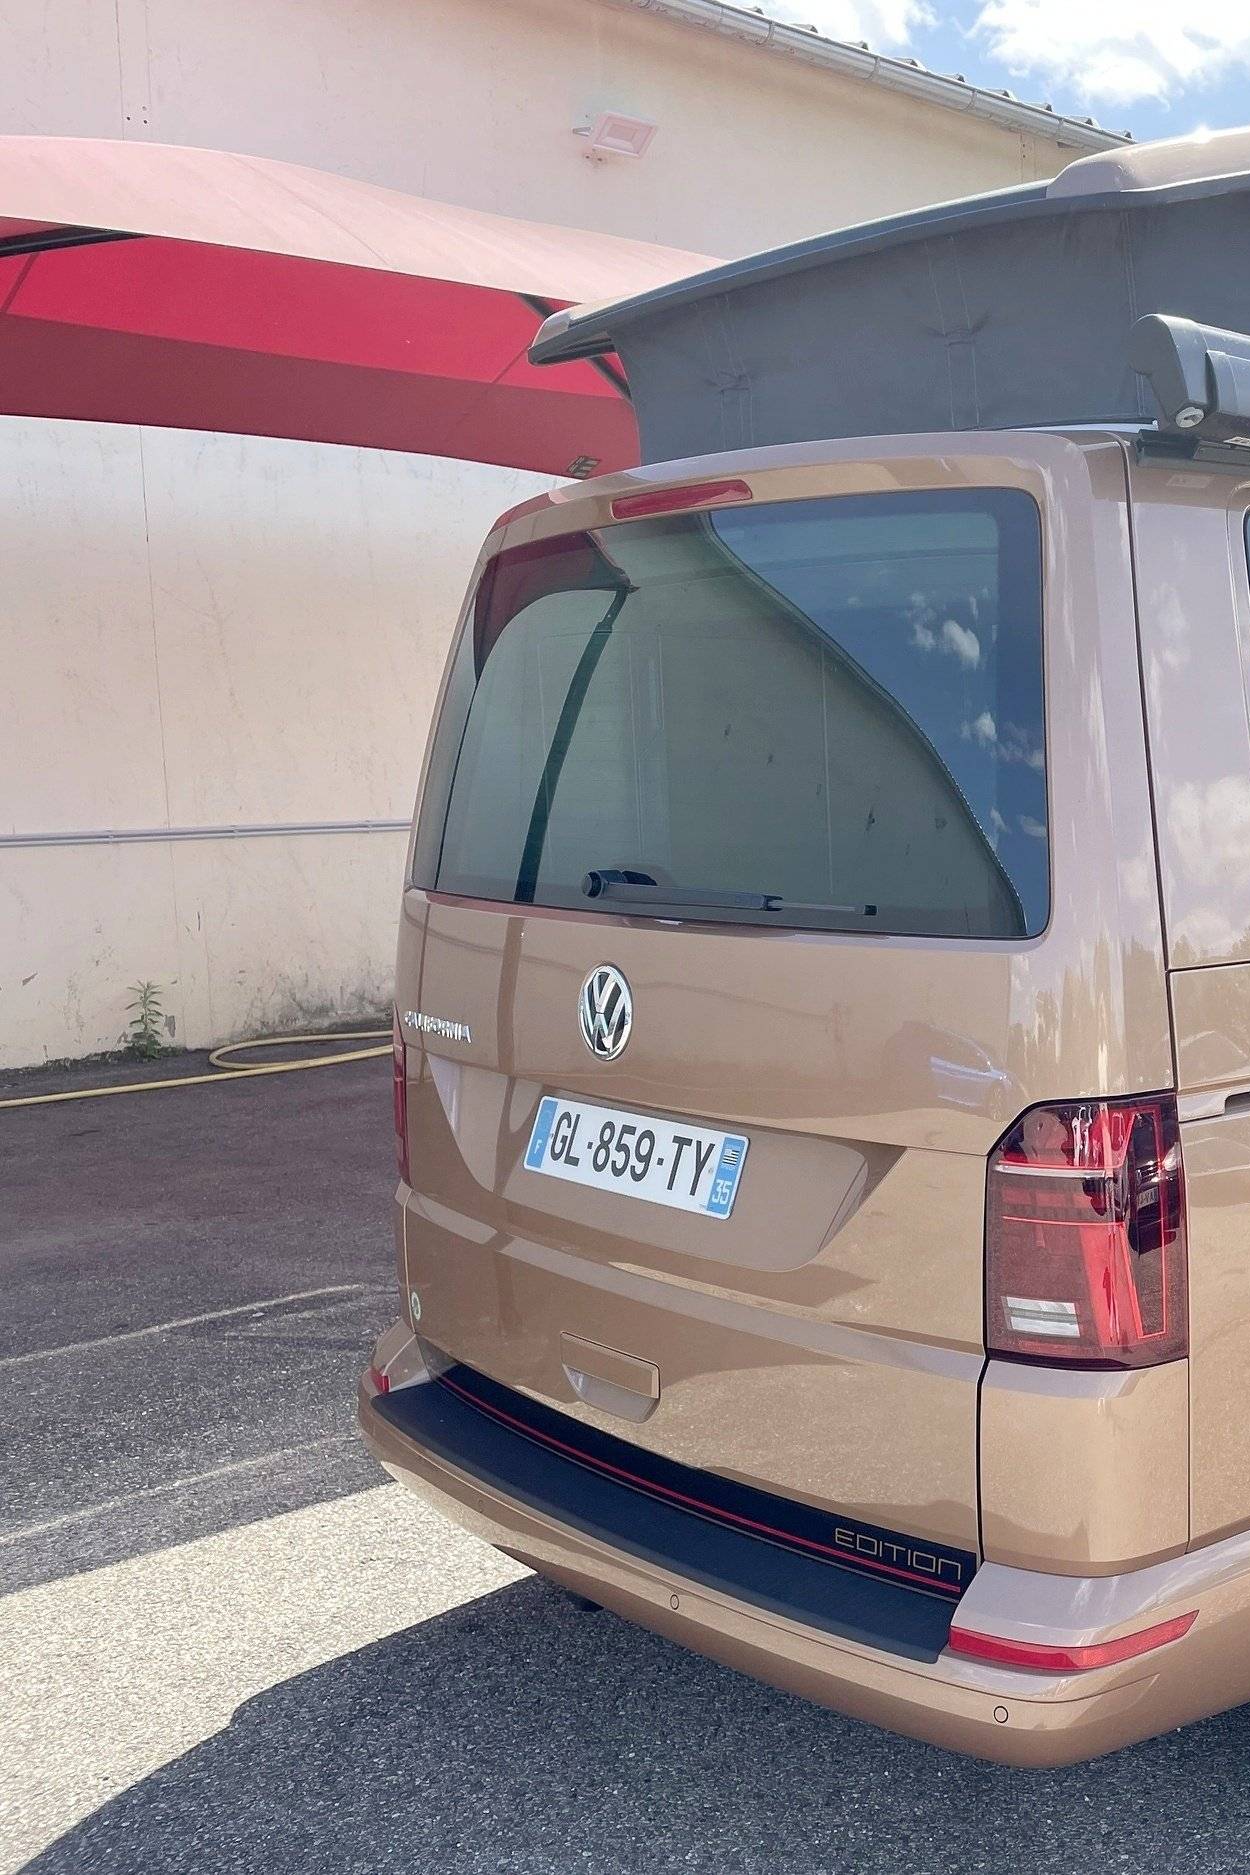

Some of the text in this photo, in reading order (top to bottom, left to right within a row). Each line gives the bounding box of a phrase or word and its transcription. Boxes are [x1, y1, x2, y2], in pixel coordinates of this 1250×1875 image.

[533, 1140, 543, 1154] F
[711, 1178, 733, 1205] 35
[834, 1527, 962, 1581] EDITION
